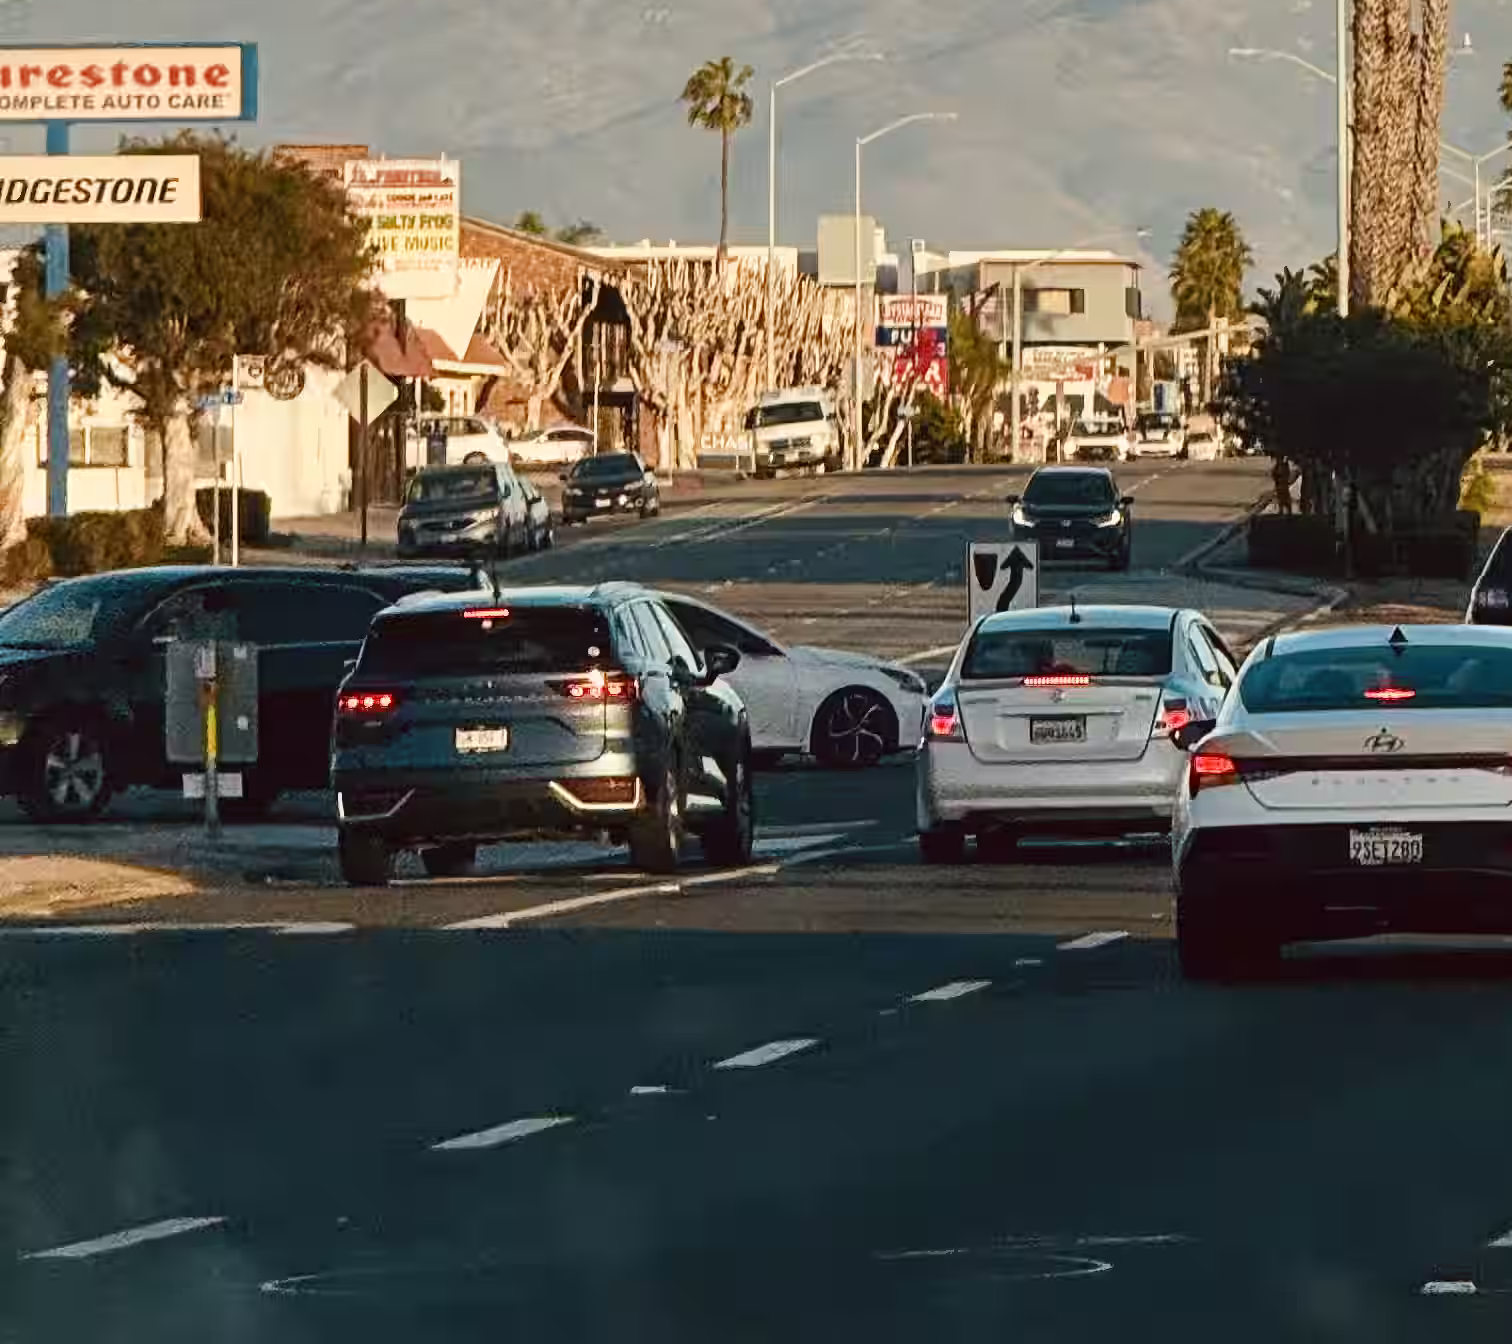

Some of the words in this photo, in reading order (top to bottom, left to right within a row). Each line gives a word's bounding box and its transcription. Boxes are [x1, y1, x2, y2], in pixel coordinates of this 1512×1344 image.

[0, 63, 230, 88] irestone
[0, 95, 95, 110] OMPLETE
[101, 95, 161, 109] AUTO
[168, 94, 225, 109] CARE
[0, 177, 180, 204] IDGESTONE
